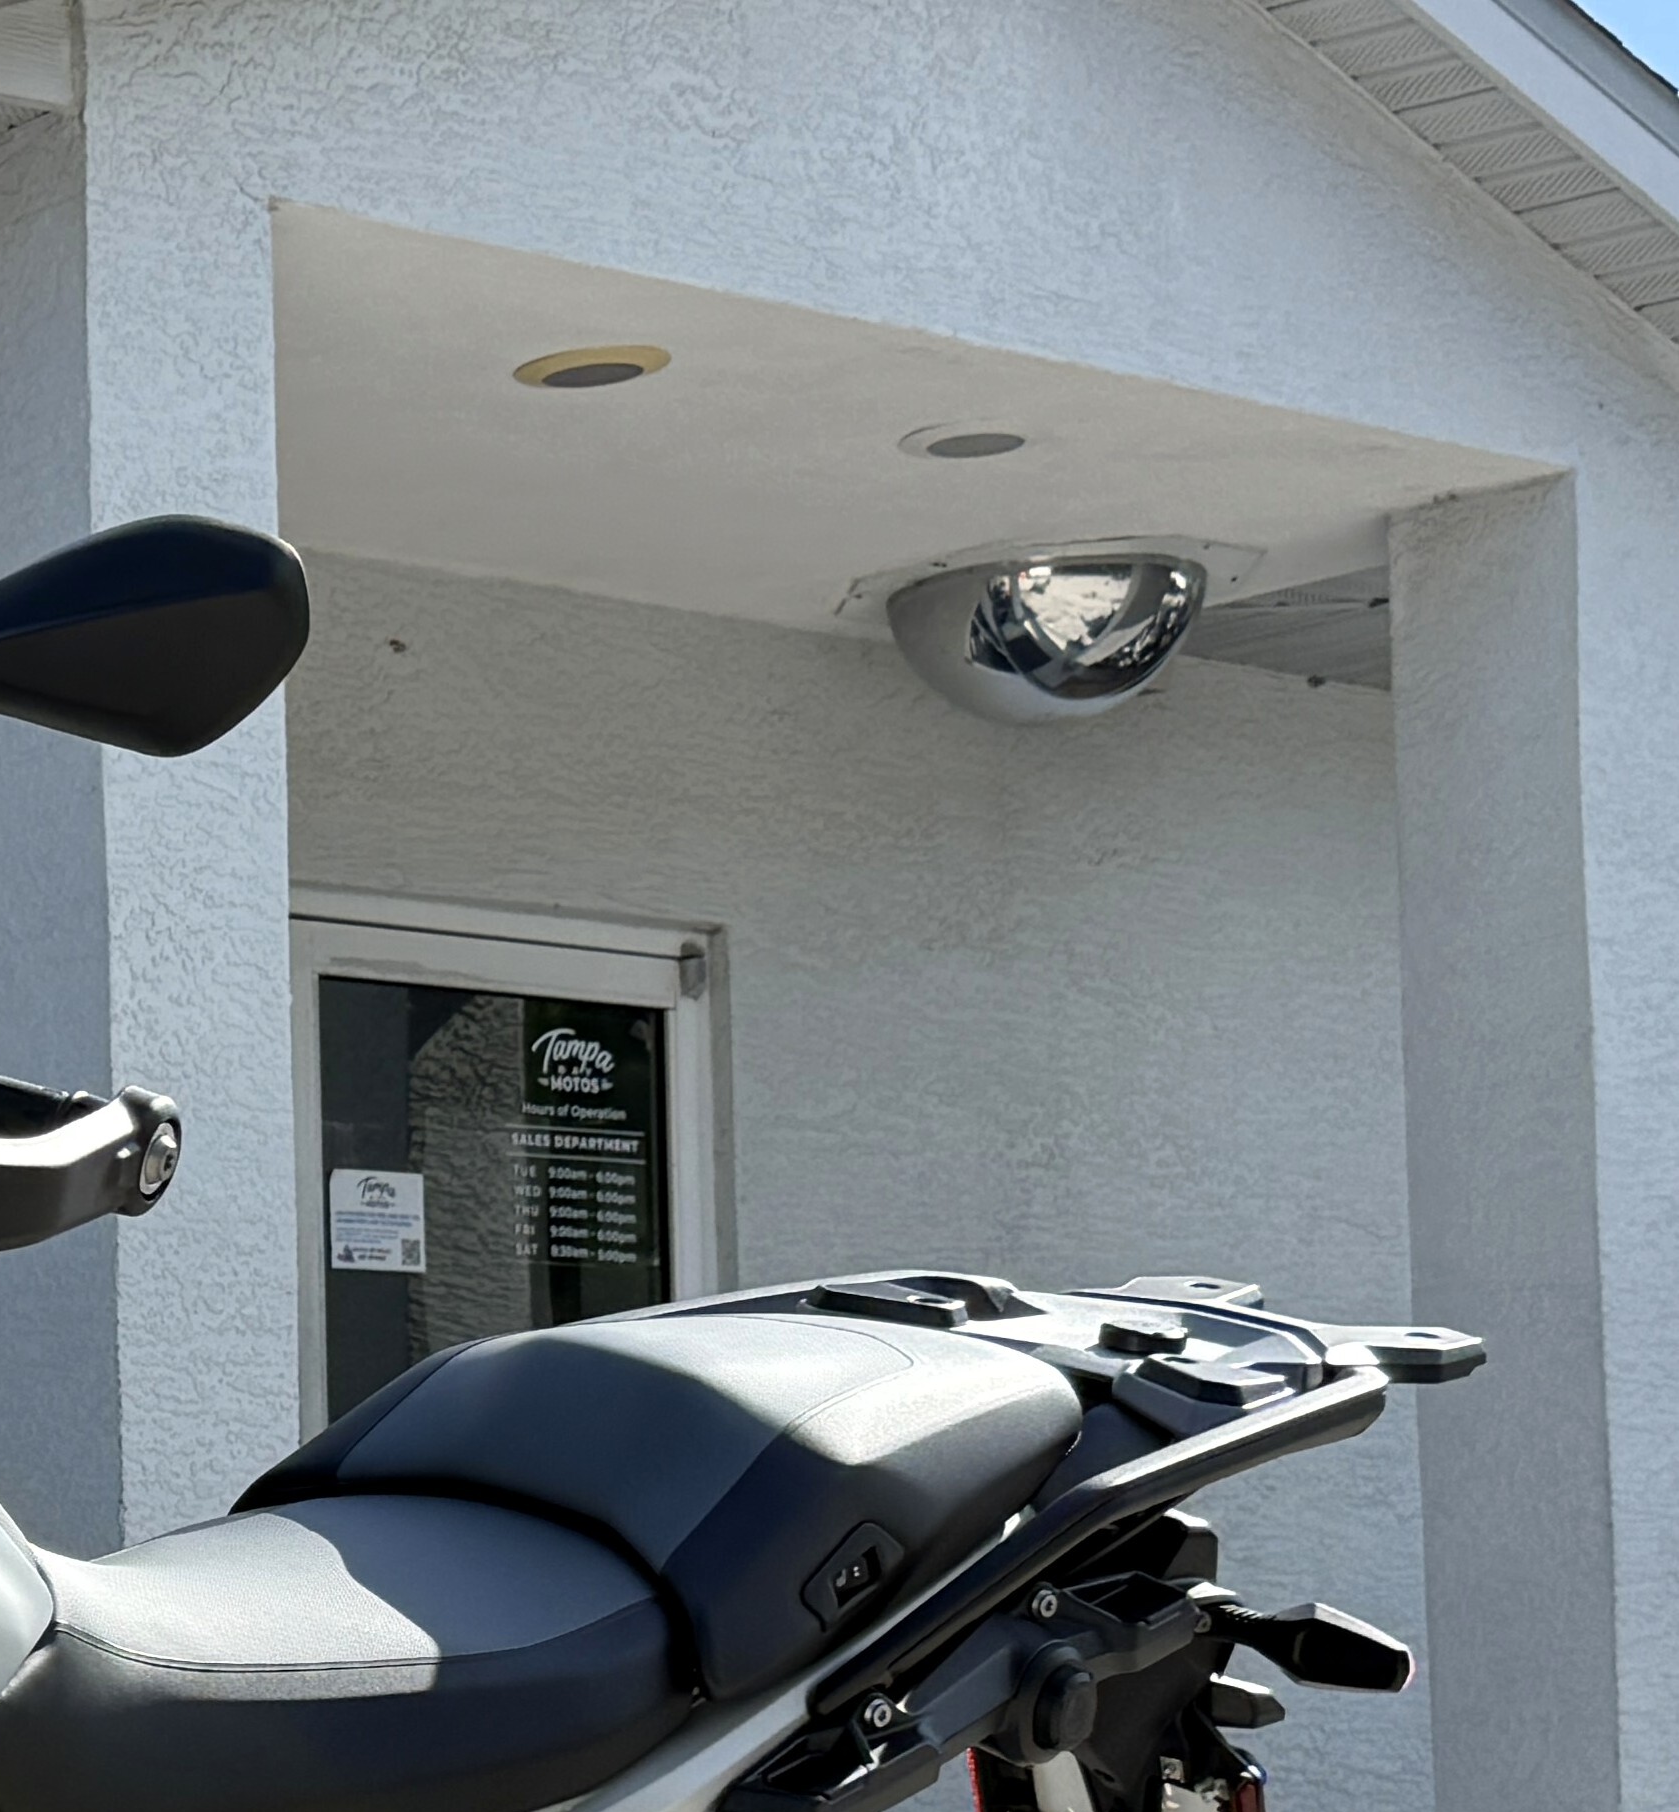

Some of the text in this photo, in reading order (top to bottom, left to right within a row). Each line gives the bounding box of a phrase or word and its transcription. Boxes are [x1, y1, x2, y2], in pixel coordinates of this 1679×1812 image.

[531, 1028, 615, 1074] Tampa
[550, 1074, 600, 1094] MOTOS
[521, 1102, 627, 1121] Hours of Operation
[511, 1132, 639, 1153] SALES DEPARTMENT
[514, 1164, 537, 1178] TUE
[514, 1185, 542, 1197] WED
[514, 1204, 539, 1217] THU
[514, 1223, 536, 1235] FRI
[515, 1243, 538, 1256] SAT
